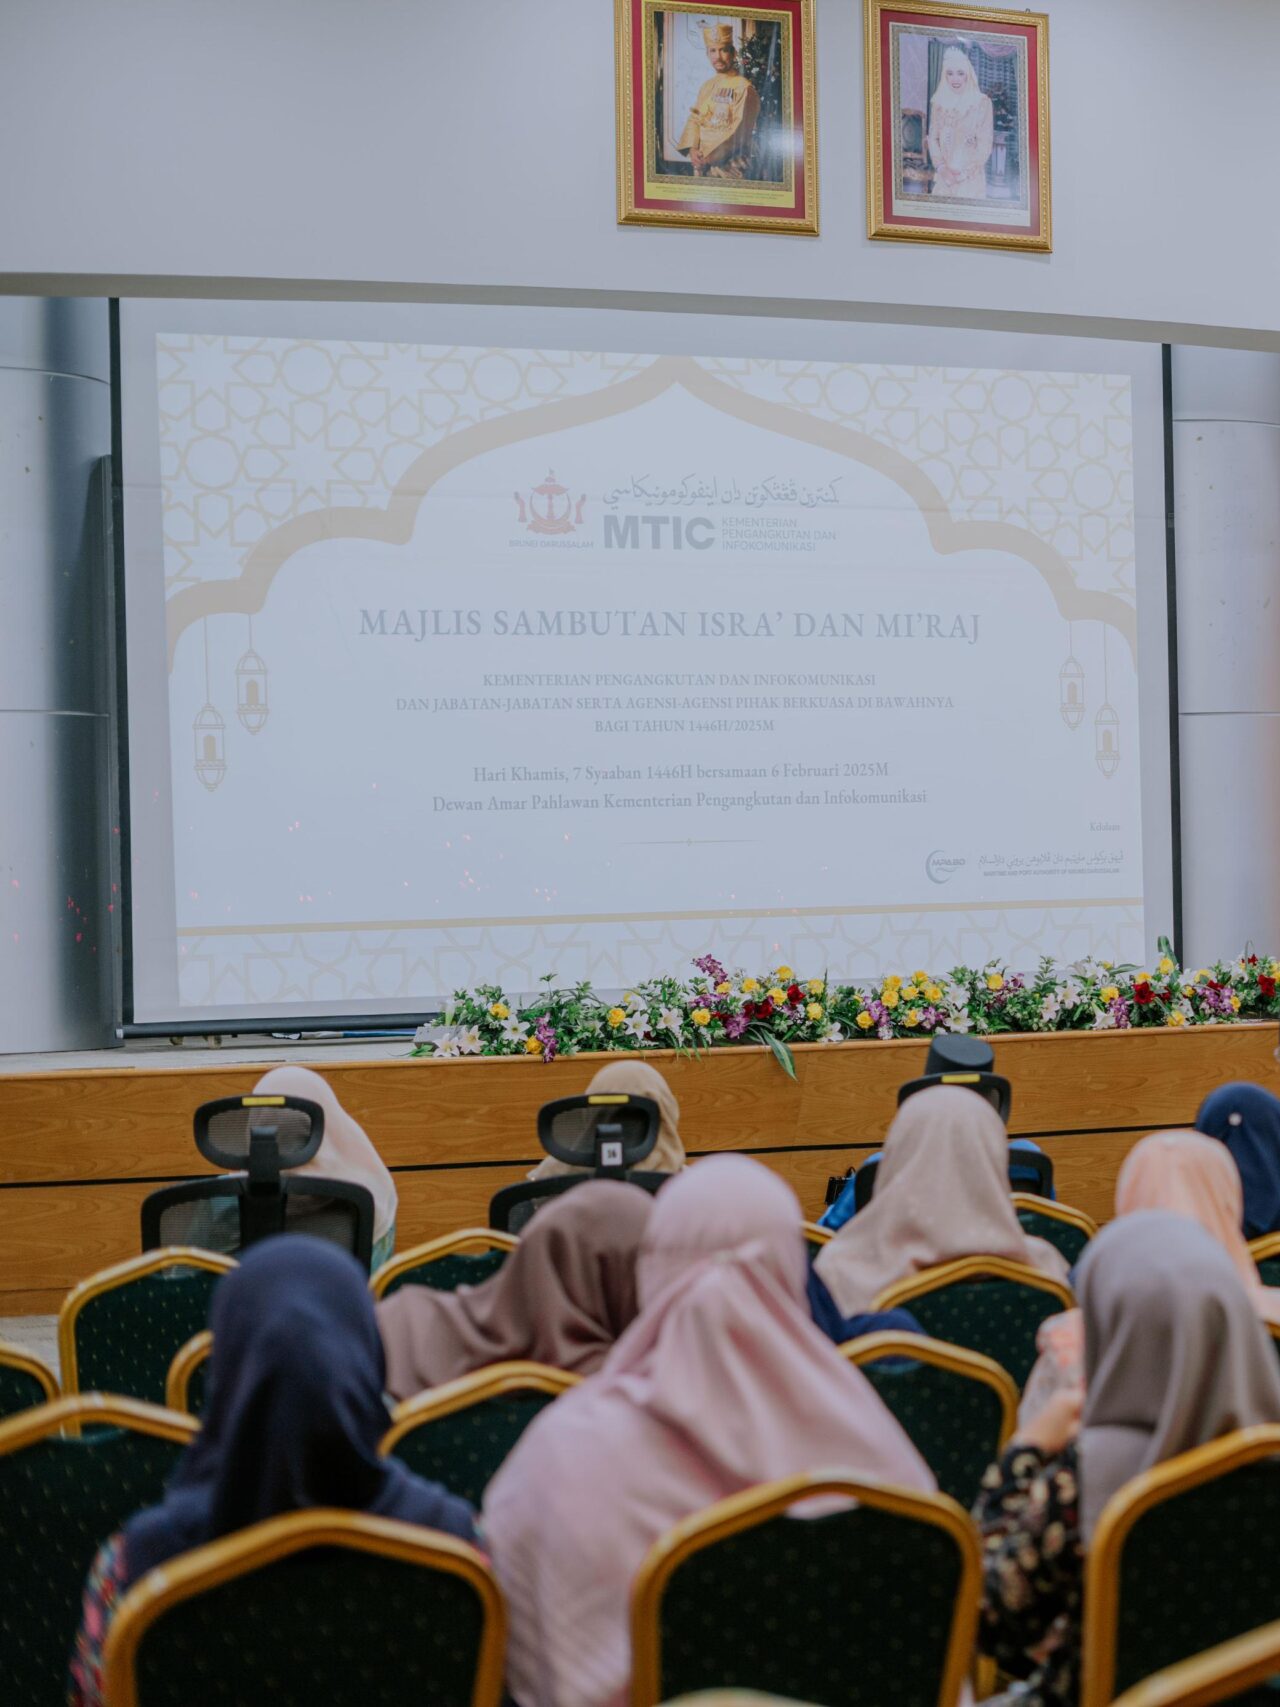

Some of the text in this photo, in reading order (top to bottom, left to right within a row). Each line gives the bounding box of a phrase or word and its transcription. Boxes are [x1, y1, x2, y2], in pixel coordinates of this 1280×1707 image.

[722, 517, 797, 528] KEMENTERIAN
[604, 515, 715, 550] MTIC
[722, 529, 836, 541] PENGANGKUTAN DAN
[722, 541, 816, 552] INFOKOMUNIKASI
[360, 609, 482, 642] MAJLIS
[494, 610, 688, 637] SAMBUTAN
[793, 613, 865, 638] DAN
[484, 673, 876, 687] KEMENTERIAN PENGANGKUTAN DAN INFOKOMUNIKASI
[396, 696, 955, 714] DAN JABATAN-JABATAN SERTA AGENSI-AGENSI PIHAK BERKUASA DI BAWAHNYA
[594, 719, 775, 733] BAGI TAHUN 1446H/2025M
[473, 761, 889, 785] Hari Khamis, 7 Syaaban 1446H bersamaan 6 Februari 2025M
[432, 788, 927, 813] Dewan Amar Pahlawan Kementerian Pengangkutan dan Infokomunikasi
